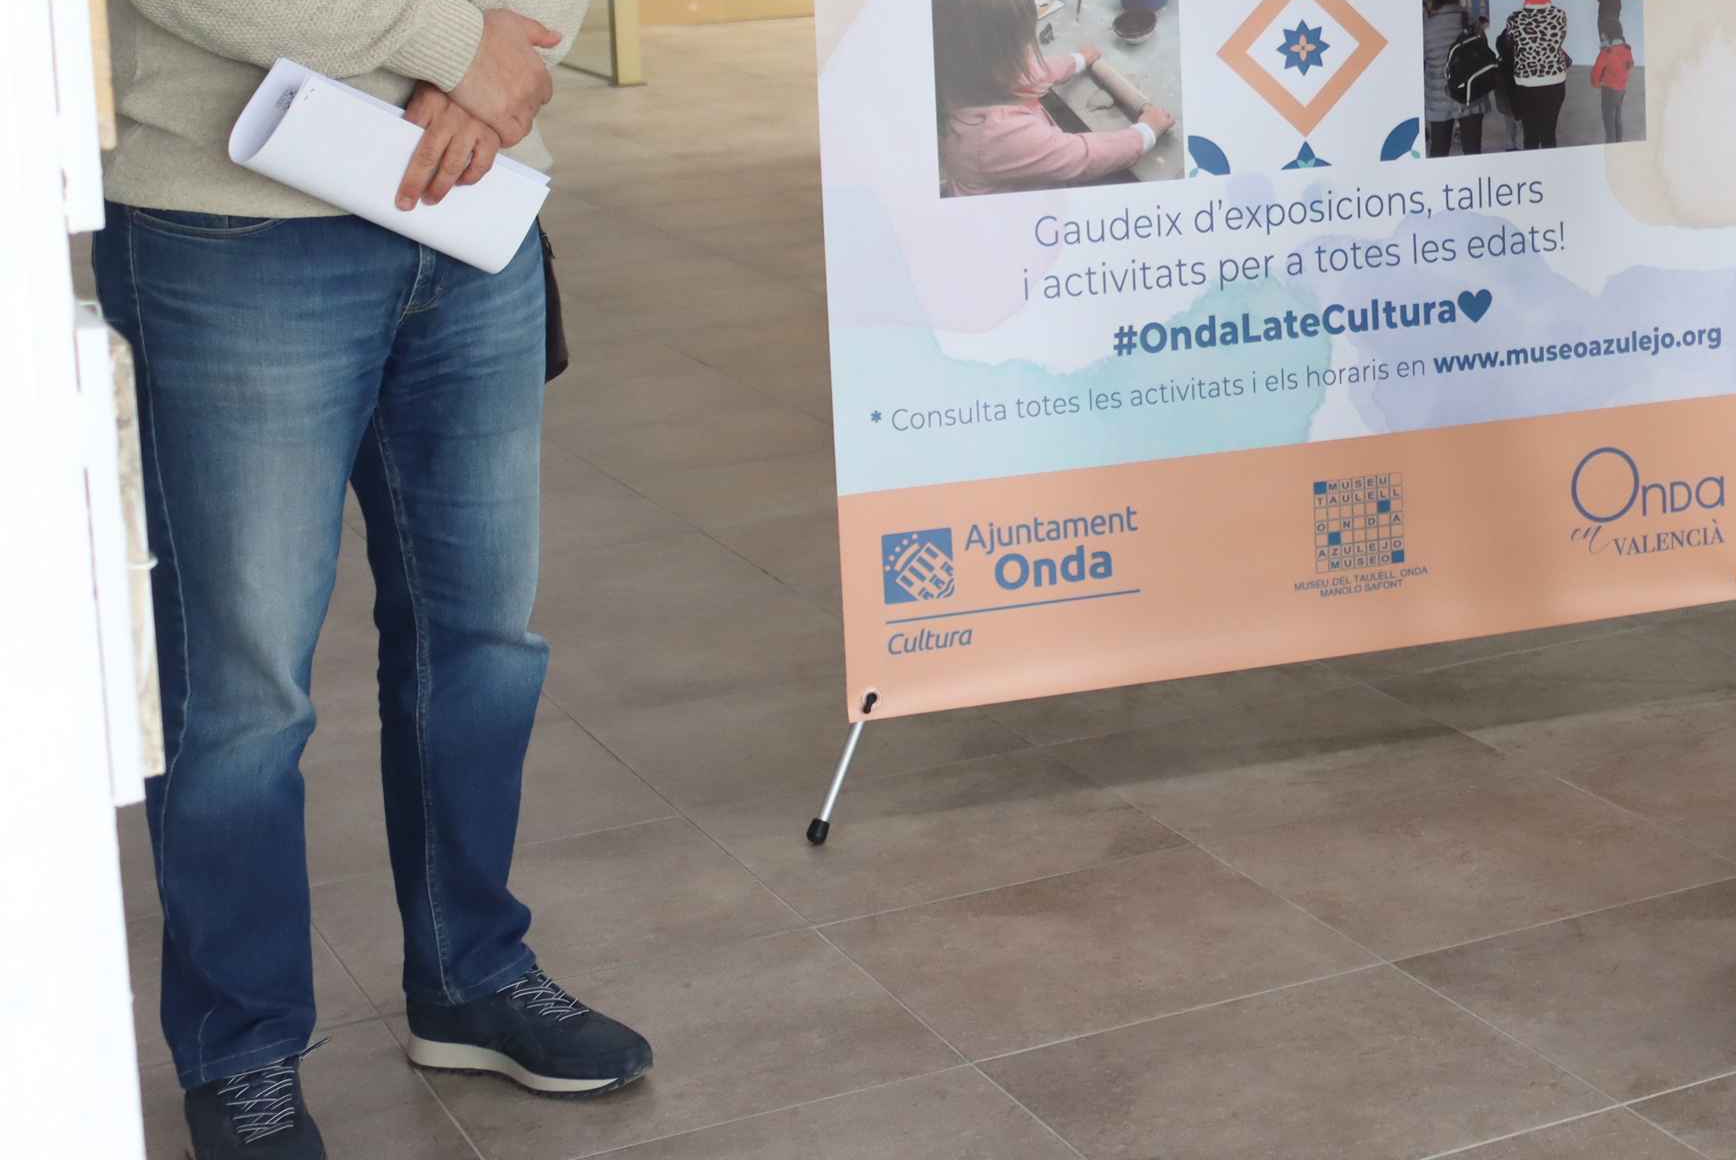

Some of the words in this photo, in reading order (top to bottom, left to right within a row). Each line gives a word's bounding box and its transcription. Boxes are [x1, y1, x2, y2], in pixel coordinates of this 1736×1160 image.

[1034, 204, 1183, 248] Gaudeix
[1193, 187, 1433, 236] d'exposicions,
[1441, 176, 1544, 212] tallers
[1022, 268, 1029, 301] i
[1043, 258, 1207, 300] activitats
[1218, 254, 1275, 291] per
[1286, 251, 1304, 277] a
[1314, 241, 1401, 274] totes
[1412, 232, 1457, 265] les
[1467, 221, 1566, 259] edats!
[1113, 298, 1458, 357] #OndaLateCultura
[890, 399, 1008, 432] Consulta
[1014, 394, 1081, 420] totes
[1088, 387, 1123, 411] les
[1129, 376, 1245, 407] activitats
[1251, 370, 1258, 394] i
[1264, 368, 1299, 393] els
[1305, 359, 1390, 388] horaris
[1396, 358, 1426, 378] en
[1432, 324, 1723, 375] www.museoazulejo.org
[1316, 487, 1401, 506] TAULELL
[1327, 476, 1388, 493] MUSEU
[963, 505, 1139, 556] Ajuntament
[1612, 518, 1726, 557] VALENCIÀ
[1317, 539, 1403, 558] AZULEJO
[1330, 554, 1391, 570] MUSEO
[994, 544, 1113, 591] Onda
[1293, 579, 1330, 592] MUSEU
[1331, 576, 1351, 587] DEL
[1399, 565, 1429, 578] ONDA
[1319, 583, 1363, 598] MANOLO
[1363, 578, 1404, 593] SAFONT
[887, 627, 974, 656] Cultura
